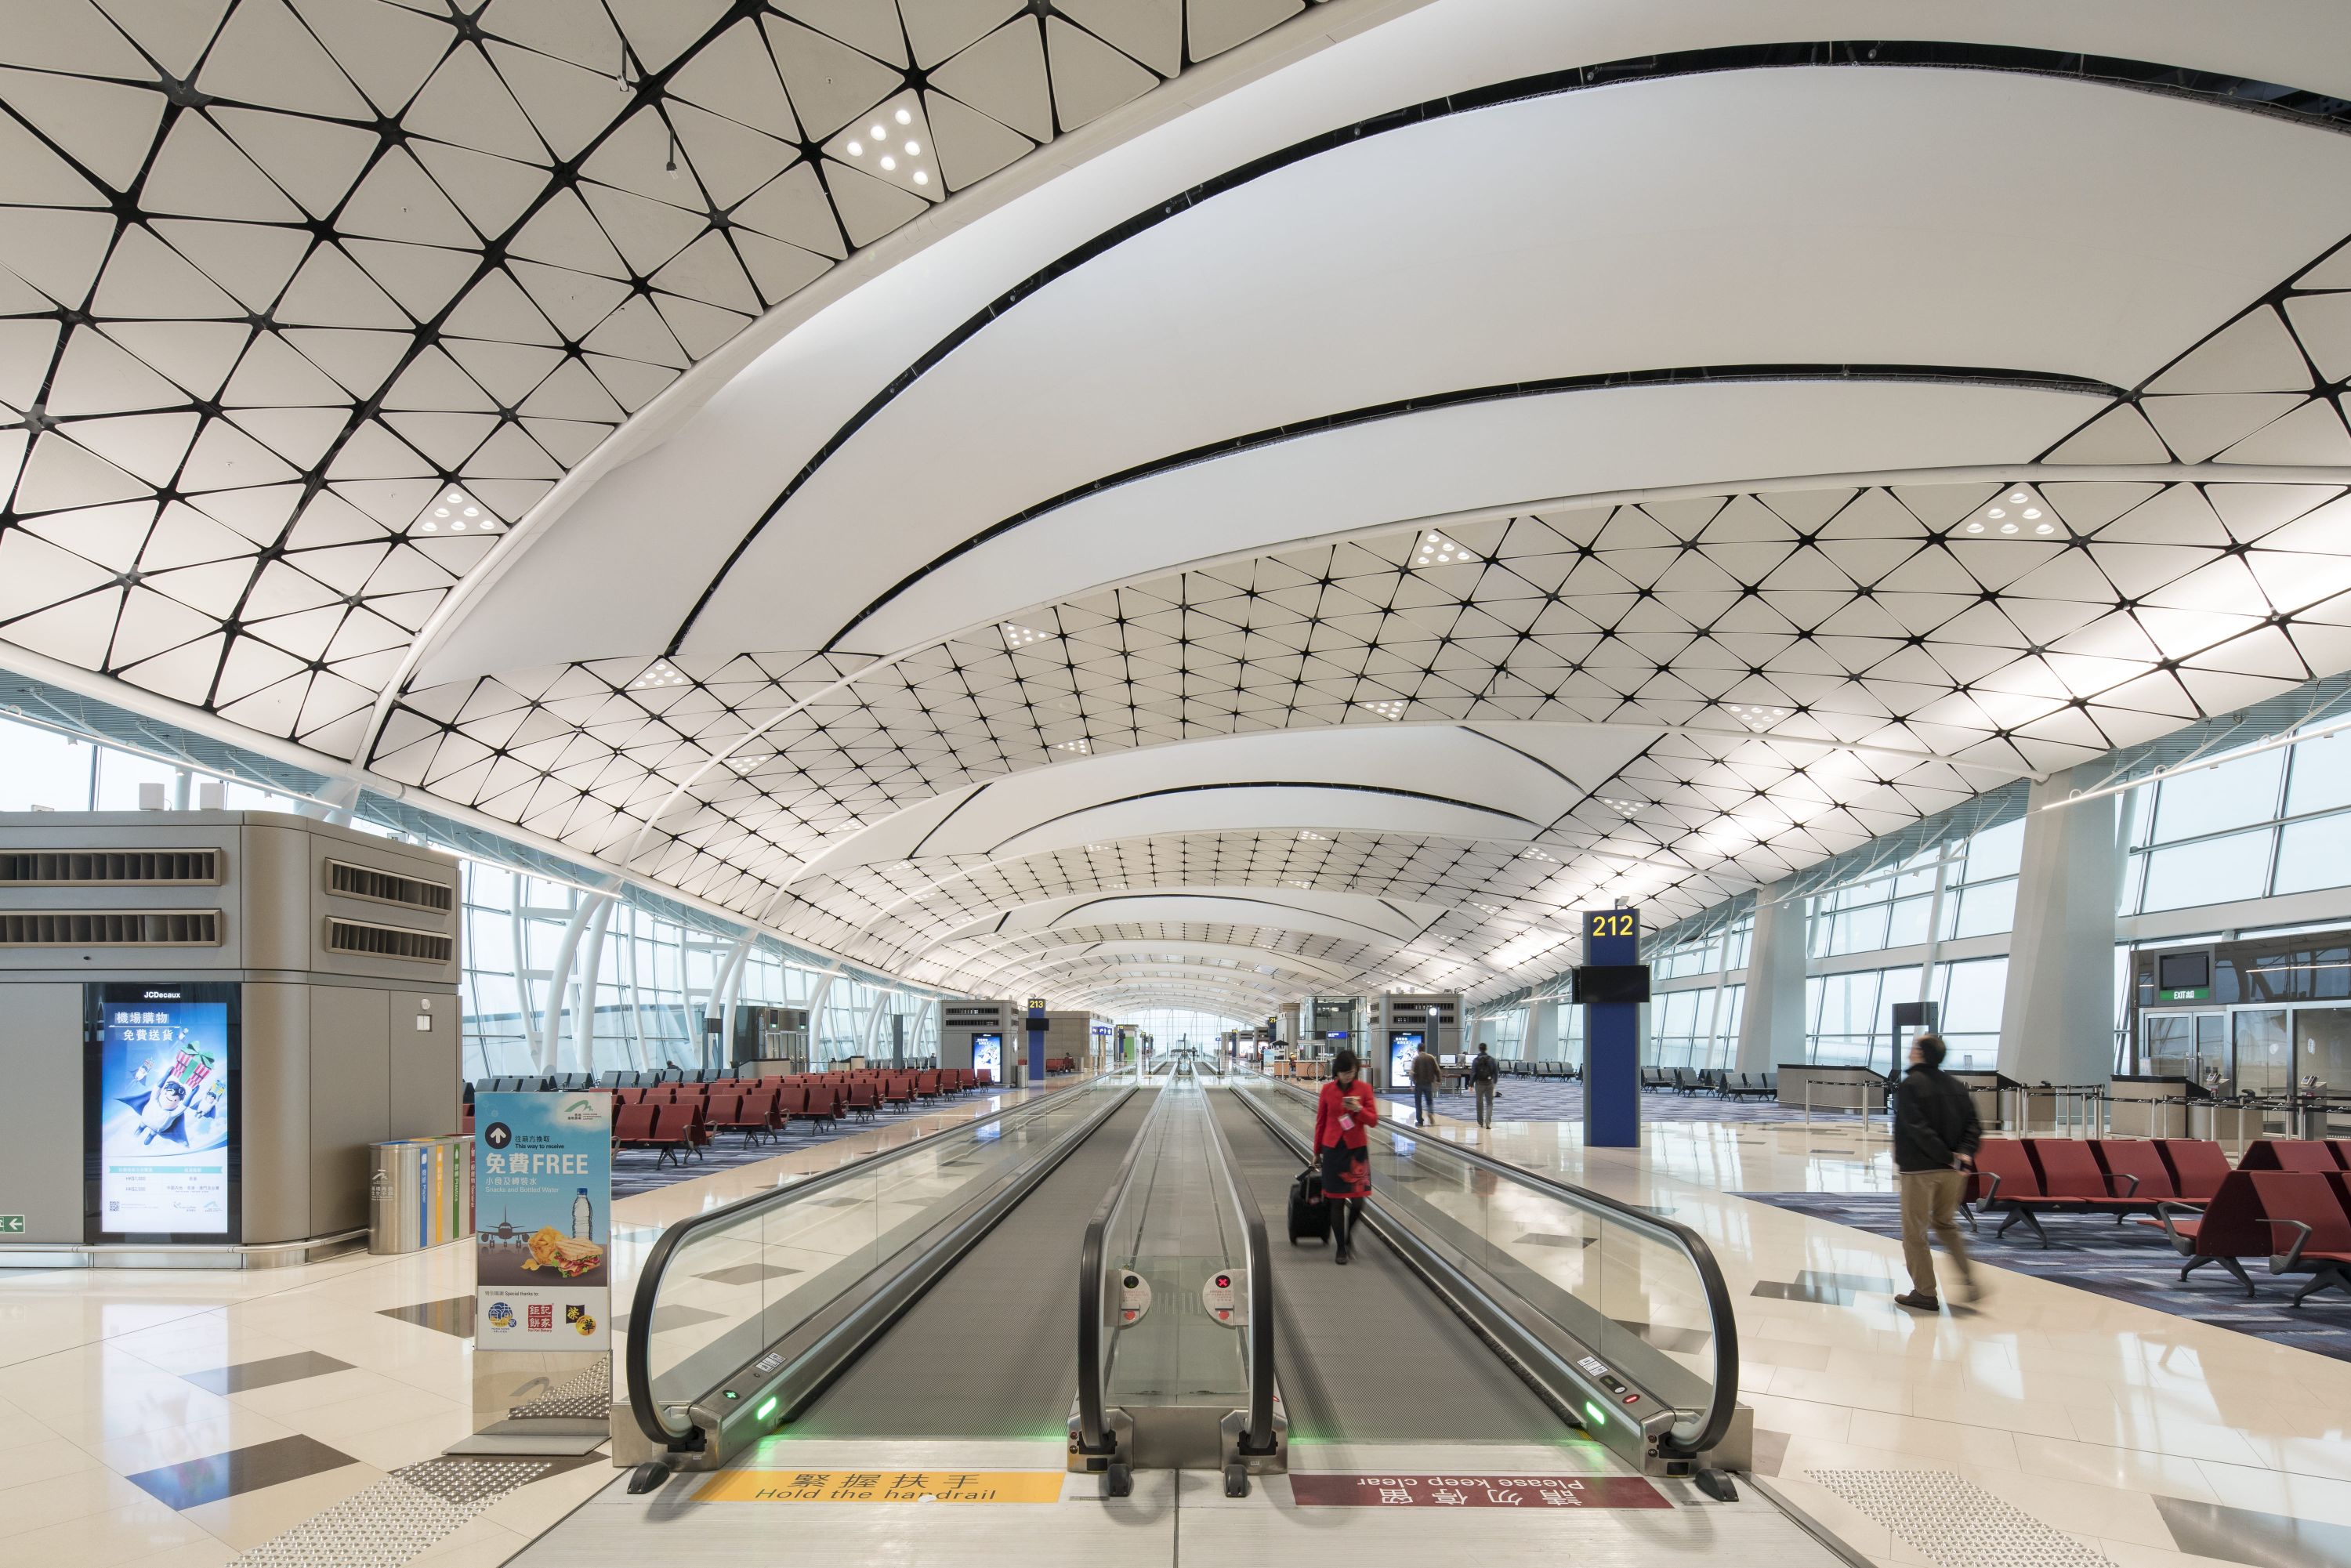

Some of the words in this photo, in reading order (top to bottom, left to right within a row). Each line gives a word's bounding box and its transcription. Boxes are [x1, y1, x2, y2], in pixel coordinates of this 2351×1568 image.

[1592, 915, 1633, 936] 212
[2173, 990, 2186, 1000] EXIT
[1030, 1000, 1044, 1009] 213
[117, 1012, 168, 1024] 機場購物
[124, 1029, 174, 1041] 免費送貨
[486, 1153, 529, 1174] 免費
[533, 1154, 589, 1175] FREE
[529, 1318, 552, 1328] 餅家
[788, 1473, 980, 1489] 緊握扶手
[1357, 1478, 1418, 1488] clear
[1428, 1477, 1491, 1489] keep
[1498, 1479, 1585, 1490] Please
[755, 1489, 821, 1499] Hold
[831, 1490, 872, 1499] the
[1379, 1488, 1582, 1506] 請勿停留
